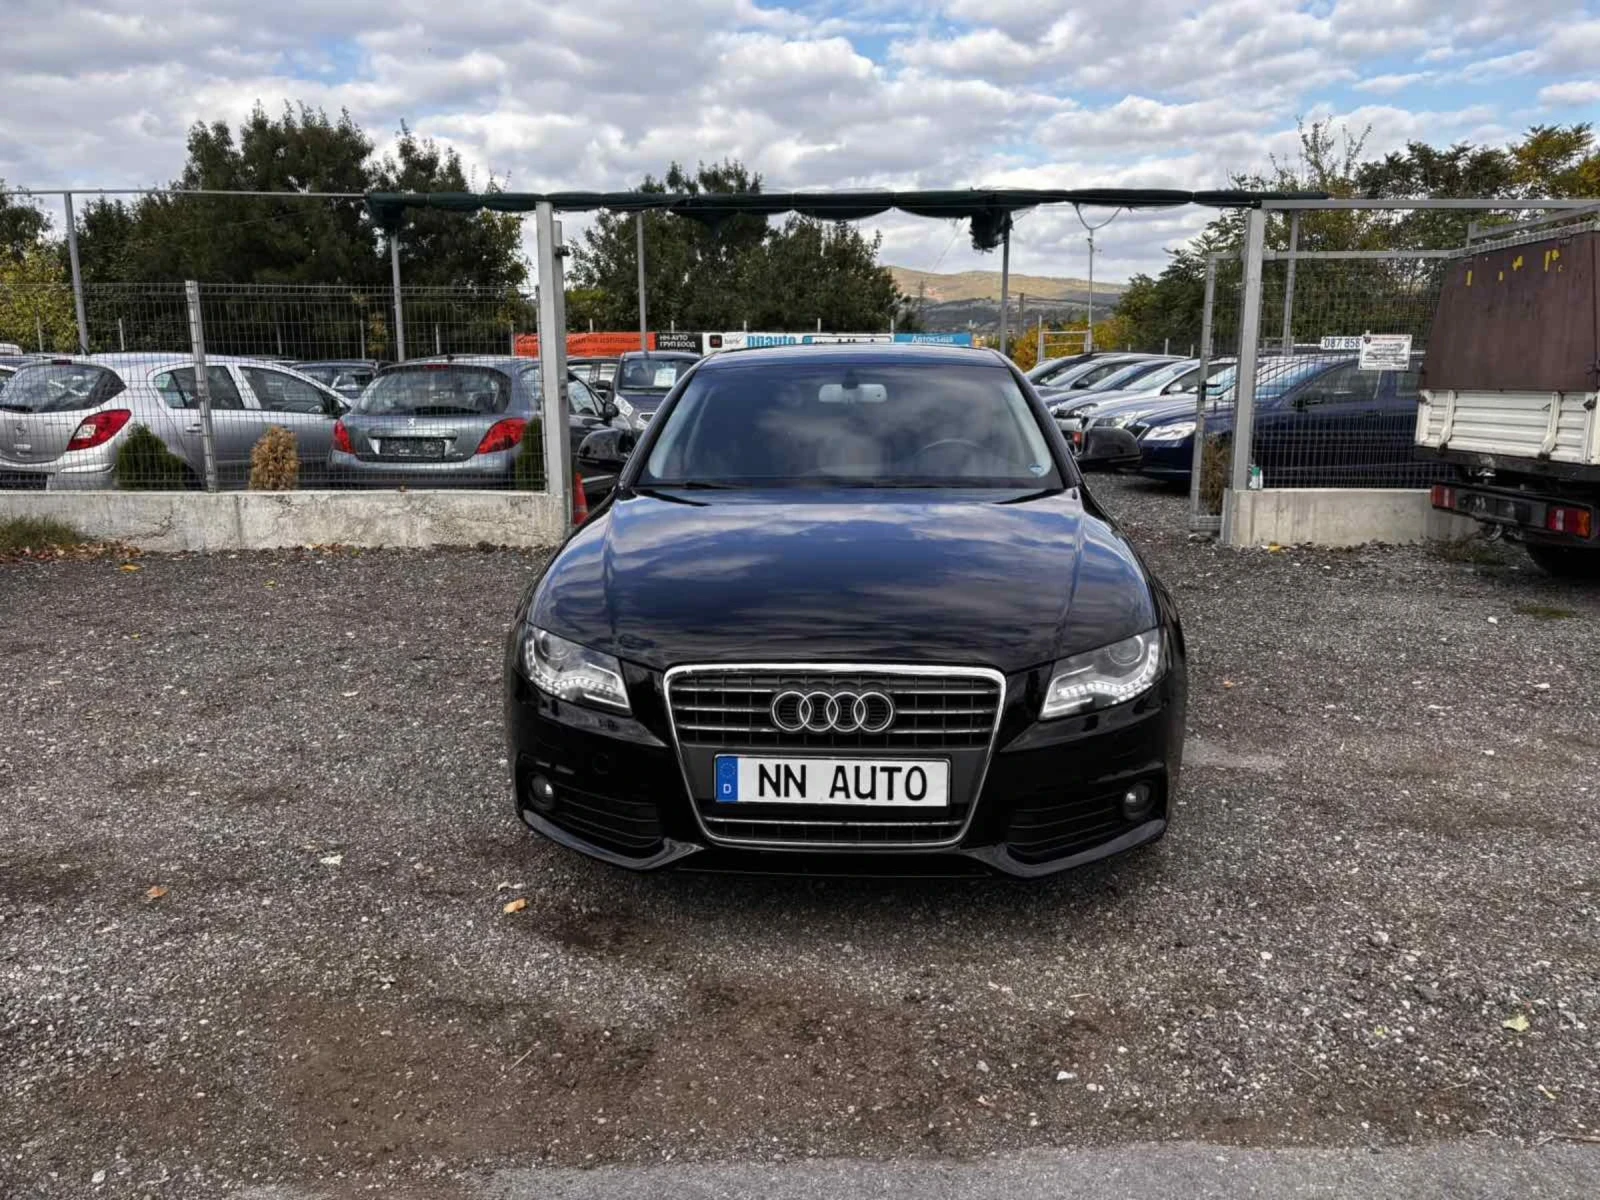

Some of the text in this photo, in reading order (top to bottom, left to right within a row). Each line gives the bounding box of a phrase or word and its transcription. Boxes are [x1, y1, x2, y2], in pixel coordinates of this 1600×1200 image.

[723, 784, 732, 794] D
[758, 764, 928, 801] NN AUTO
